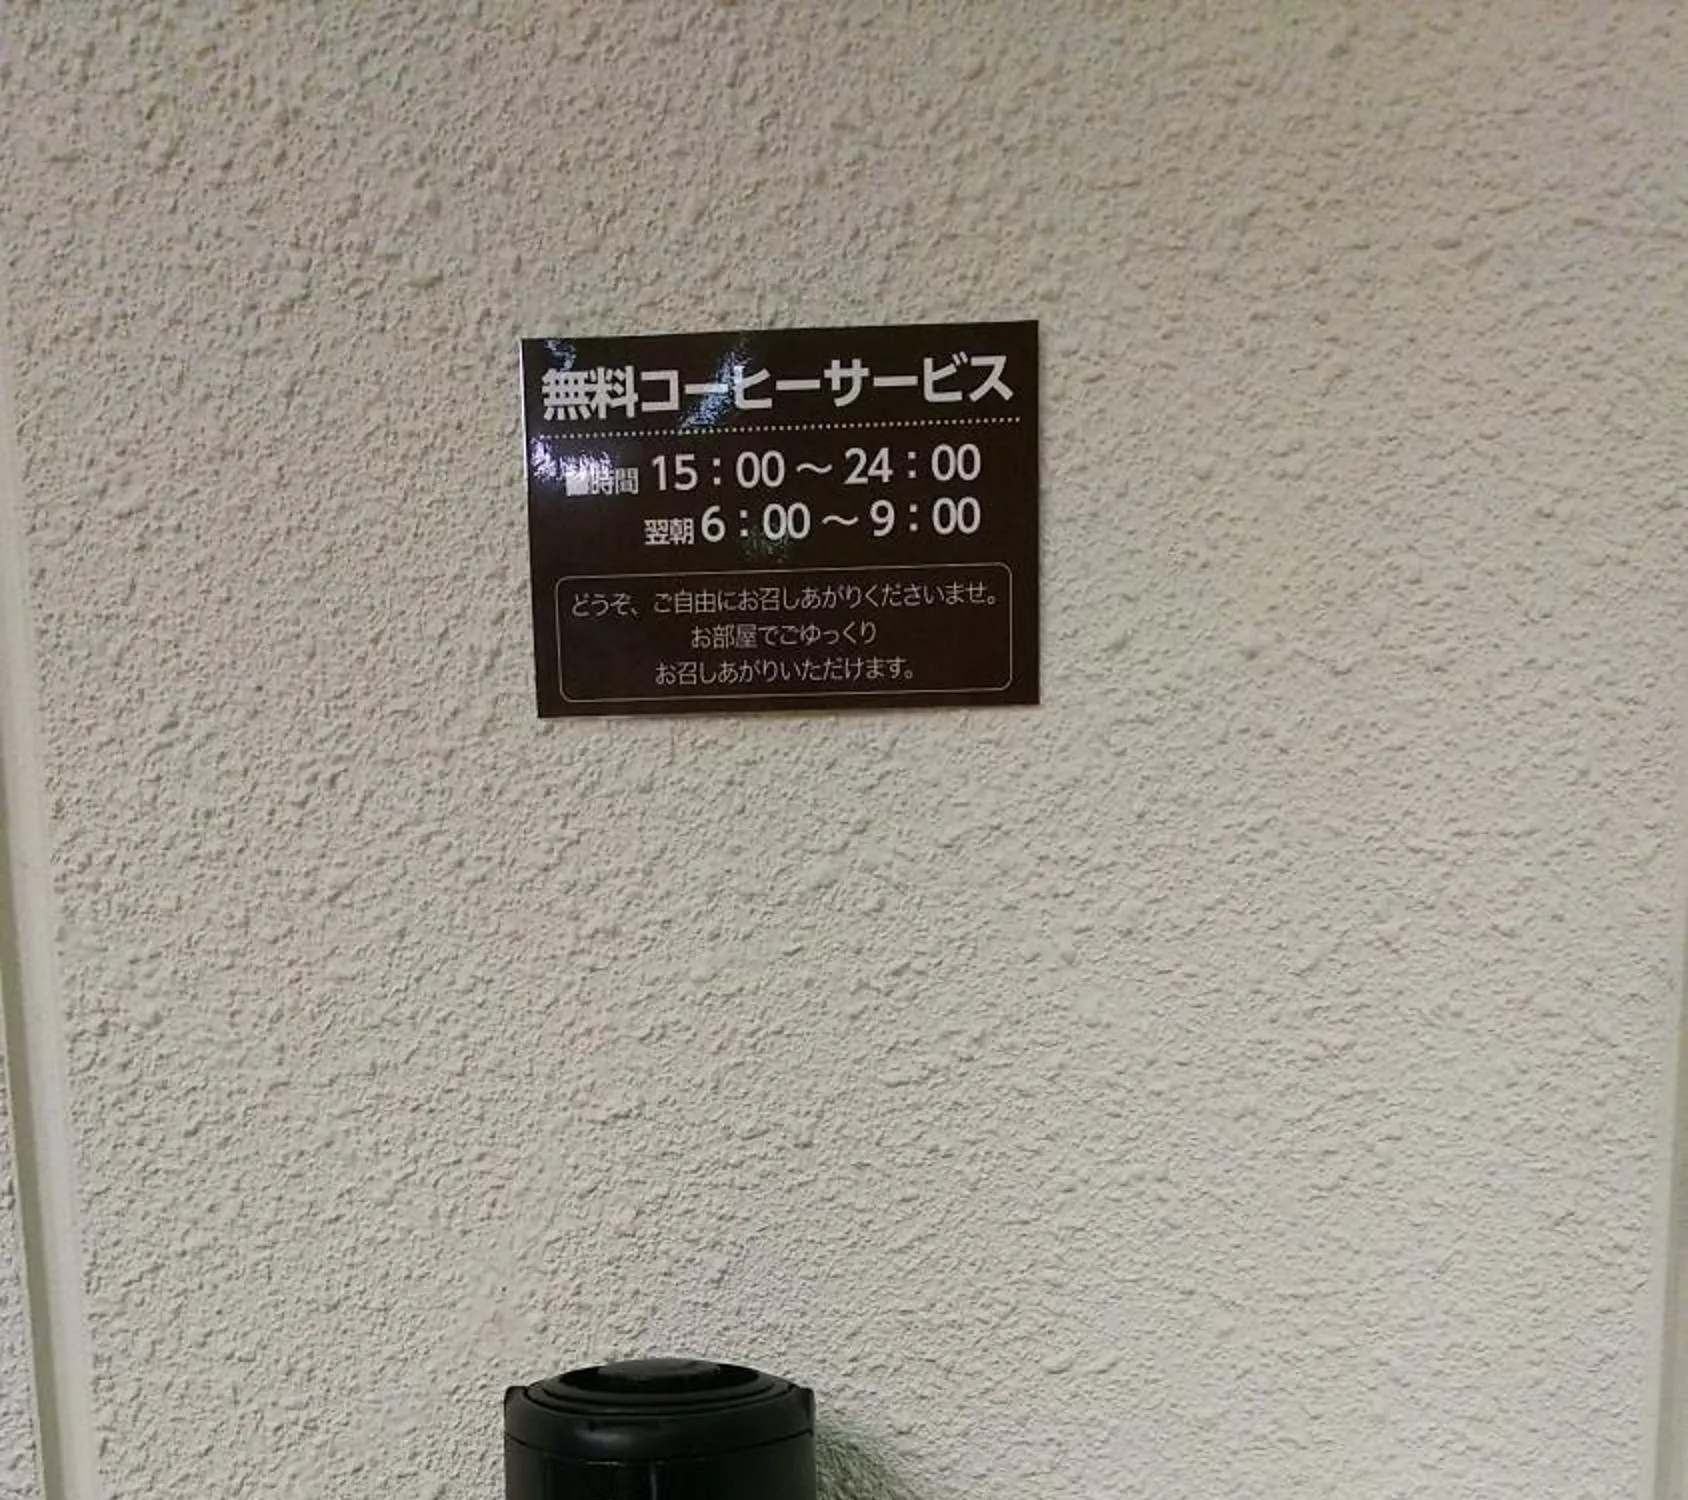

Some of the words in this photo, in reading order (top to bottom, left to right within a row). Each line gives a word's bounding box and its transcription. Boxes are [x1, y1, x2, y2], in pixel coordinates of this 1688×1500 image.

[541, 351, 1015, 421] 無料コーヒーサービス
[690, 621, 877, 649] お部屋でごゆっくり
[655, 656, 914, 686] お召しあがりいただけます。
